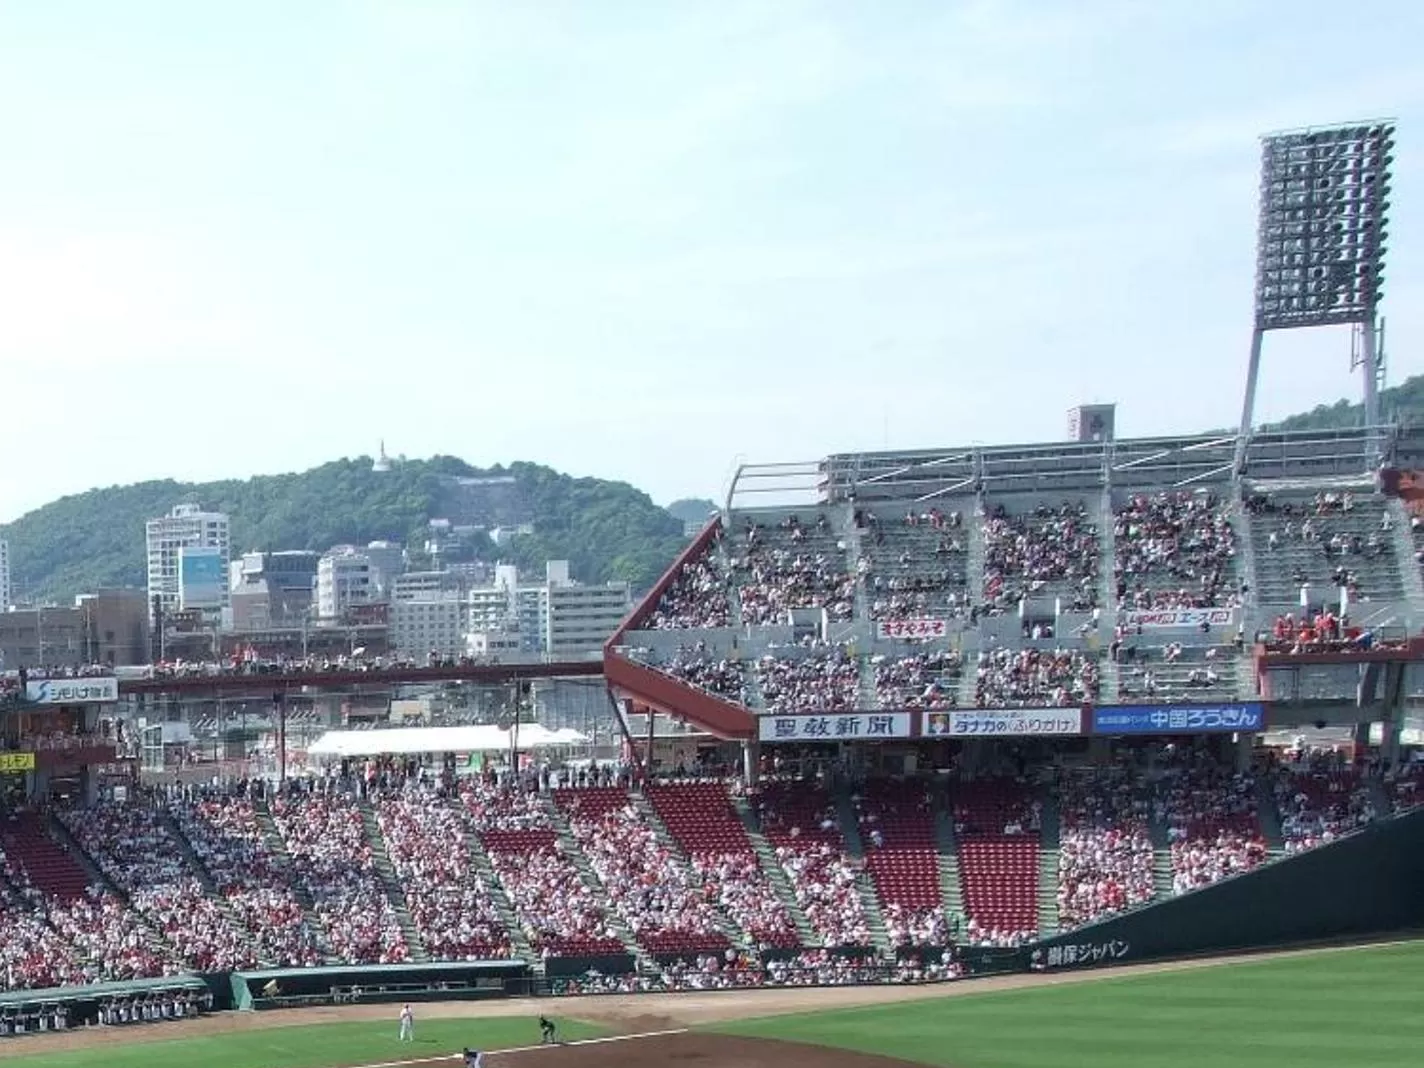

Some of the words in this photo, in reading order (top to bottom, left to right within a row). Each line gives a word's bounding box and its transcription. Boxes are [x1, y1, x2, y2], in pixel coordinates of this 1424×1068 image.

[775, 715, 894, 738] 聖教新聞
[1150, 708, 1257, 728] 中国ろうきん
